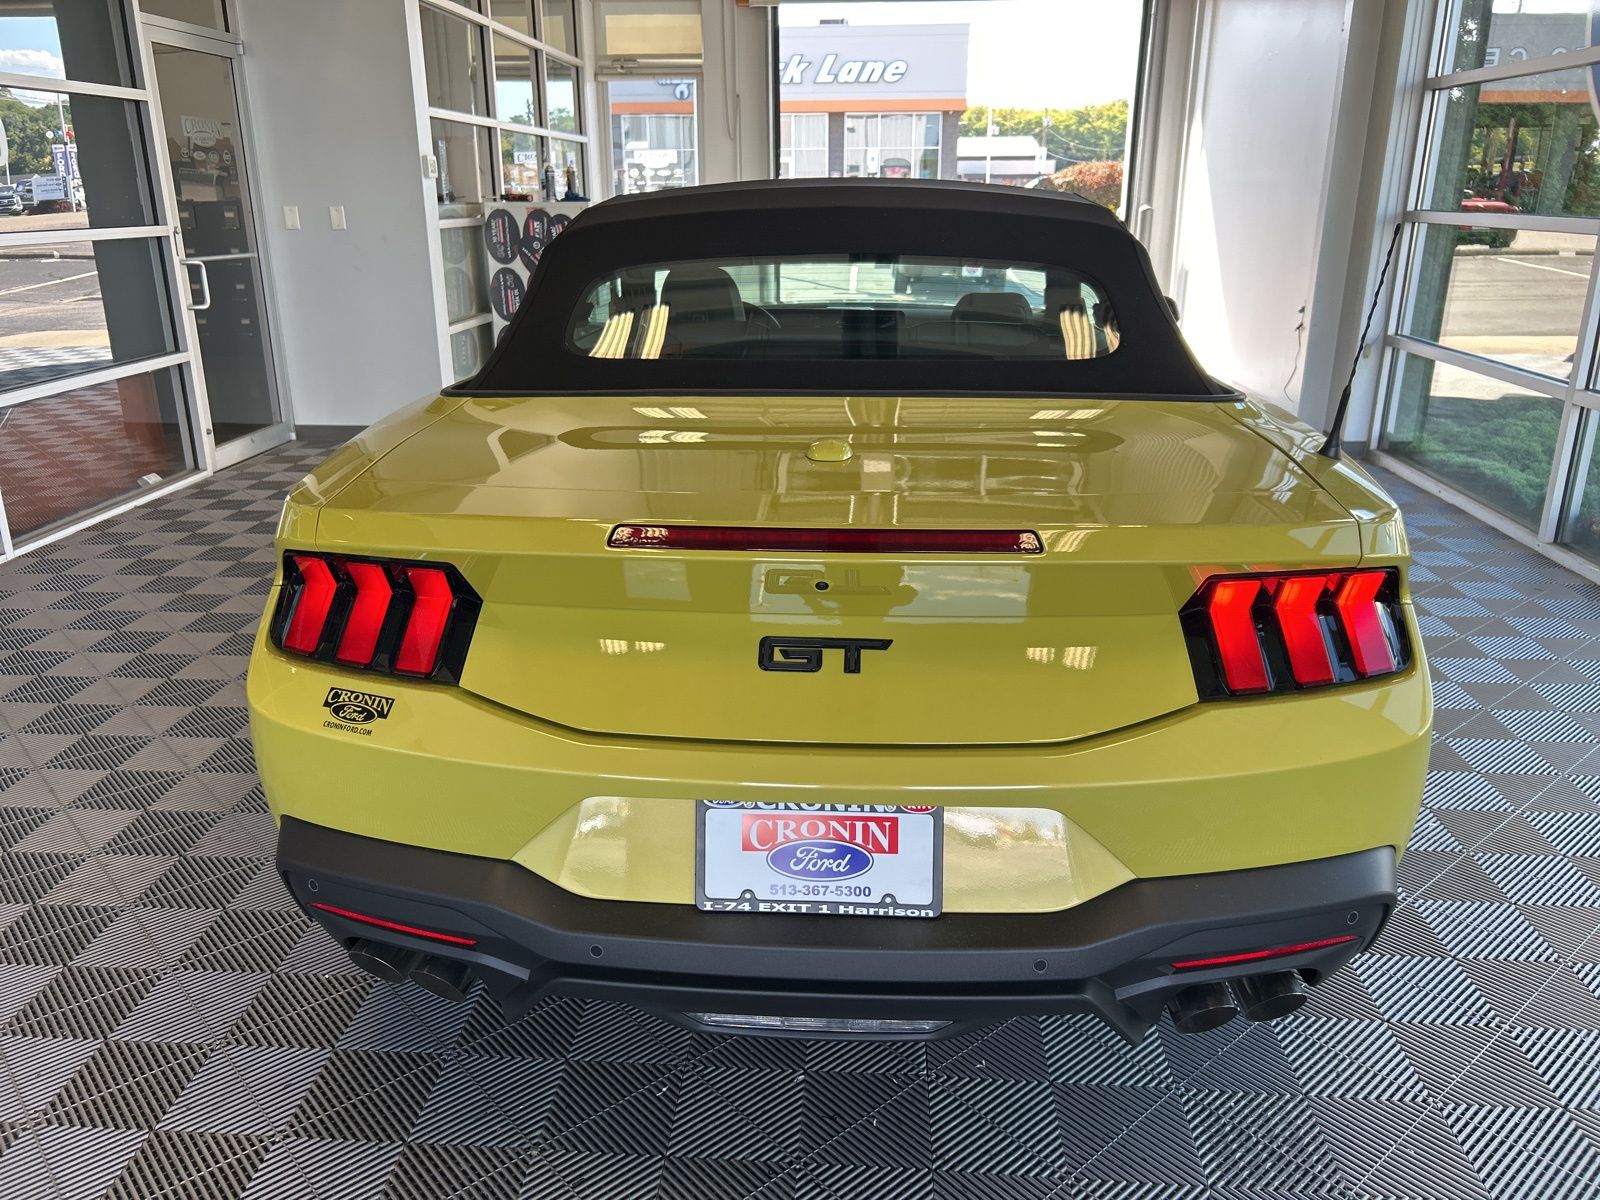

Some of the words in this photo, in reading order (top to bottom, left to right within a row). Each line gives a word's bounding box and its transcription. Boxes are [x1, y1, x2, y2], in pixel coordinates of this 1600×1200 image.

[813, 53, 908, 85] Lane
[757, 635, 893, 674] GT
[327, 688, 393, 715] CRONIN
[339, 704, 368, 722] Ford
[323, 720, 373, 736] CRONINFORD.COM
[749, 818, 892, 852] CRONIN
[789, 845, 851, 873] Ford
[769, 883, 872, 897] 513-367-5300
[703, 901, 751, 911] I-74
[758, 903, 811, 913] EXIT
[818, 905, 830, 914] 1
[838, 905, 934, 917] Harrison
